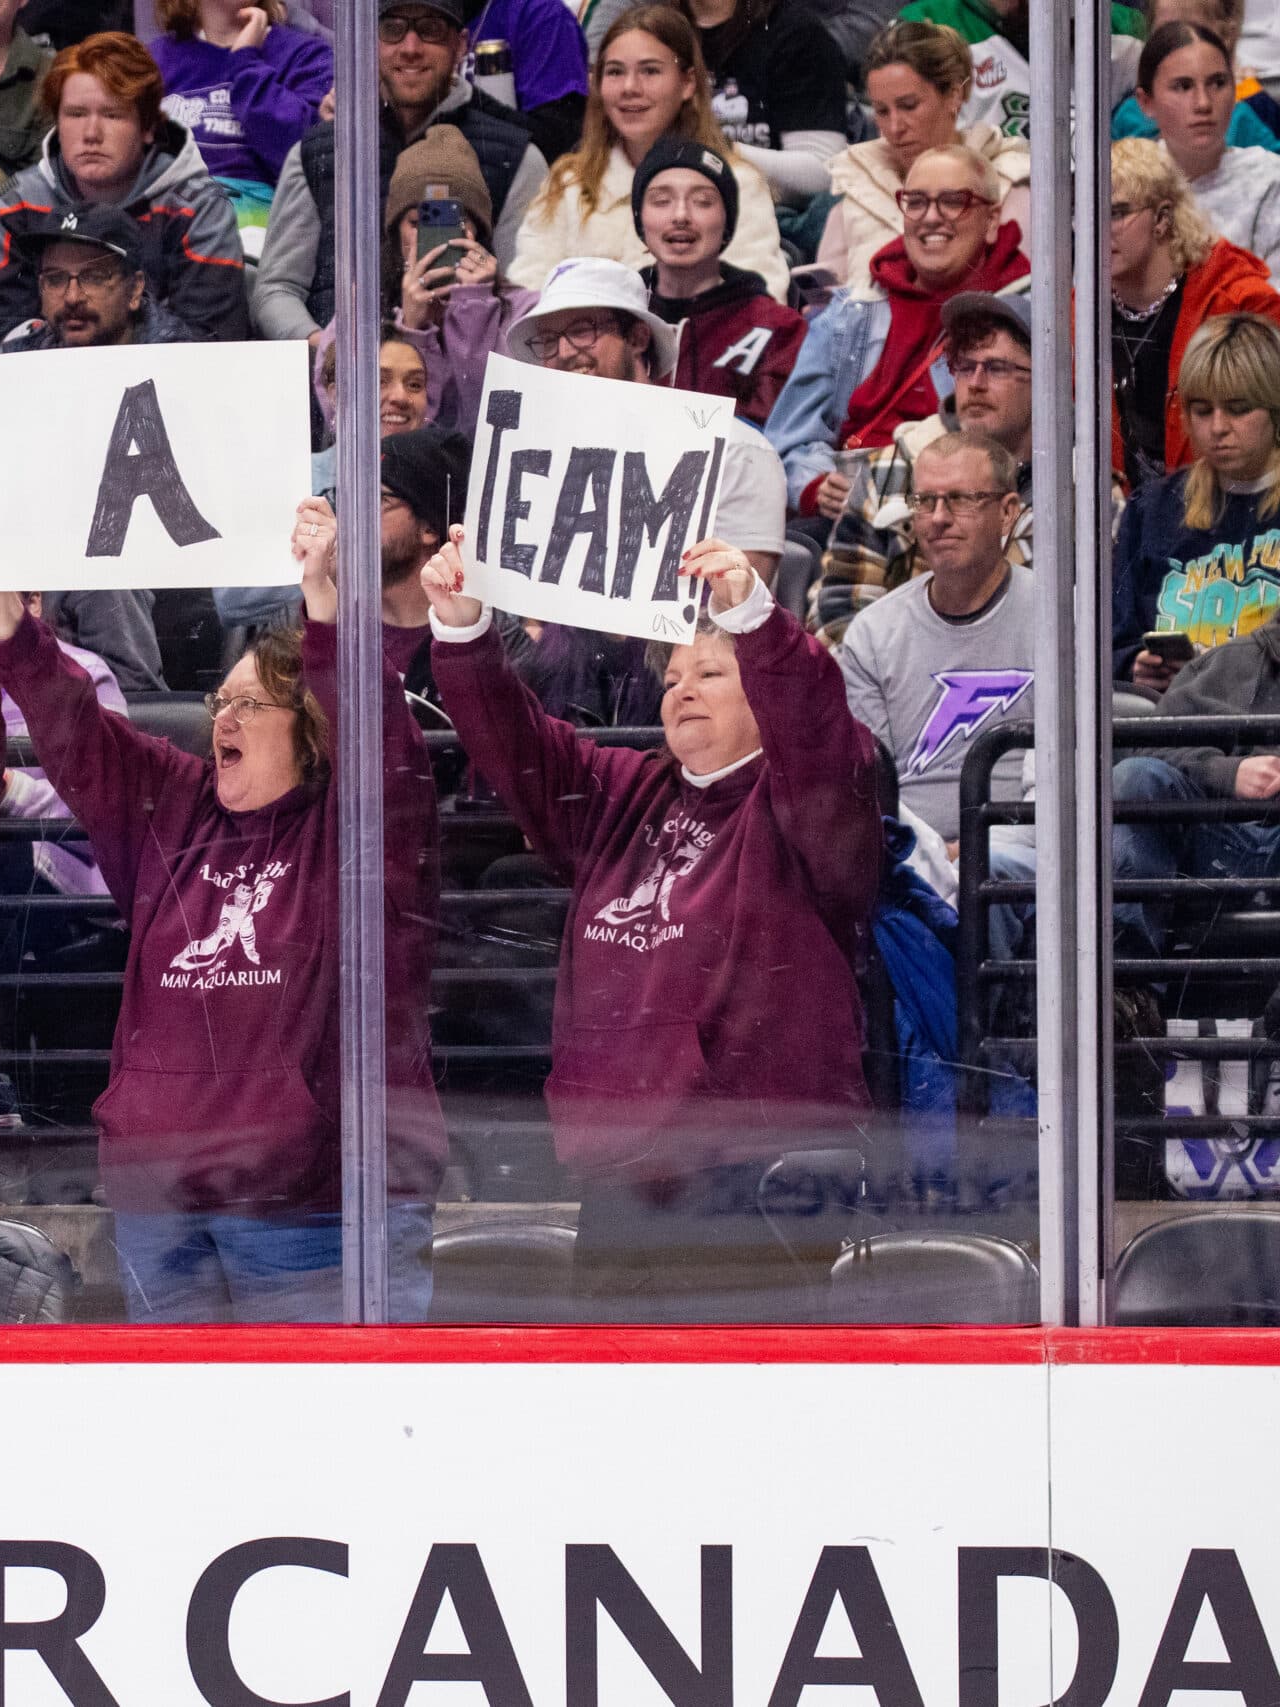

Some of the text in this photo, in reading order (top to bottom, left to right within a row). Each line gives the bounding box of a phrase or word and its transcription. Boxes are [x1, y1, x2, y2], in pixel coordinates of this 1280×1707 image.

[712, 327, 773, 376] A
[85, 379, 222, 557] A
[476, 390, 726, 624] TEAM!
[160, 969, 281, 990] MAN AQUARIUM
[584, 924, 617, 943] MAN
[183, 1535, 1280, 1707] CANADA
